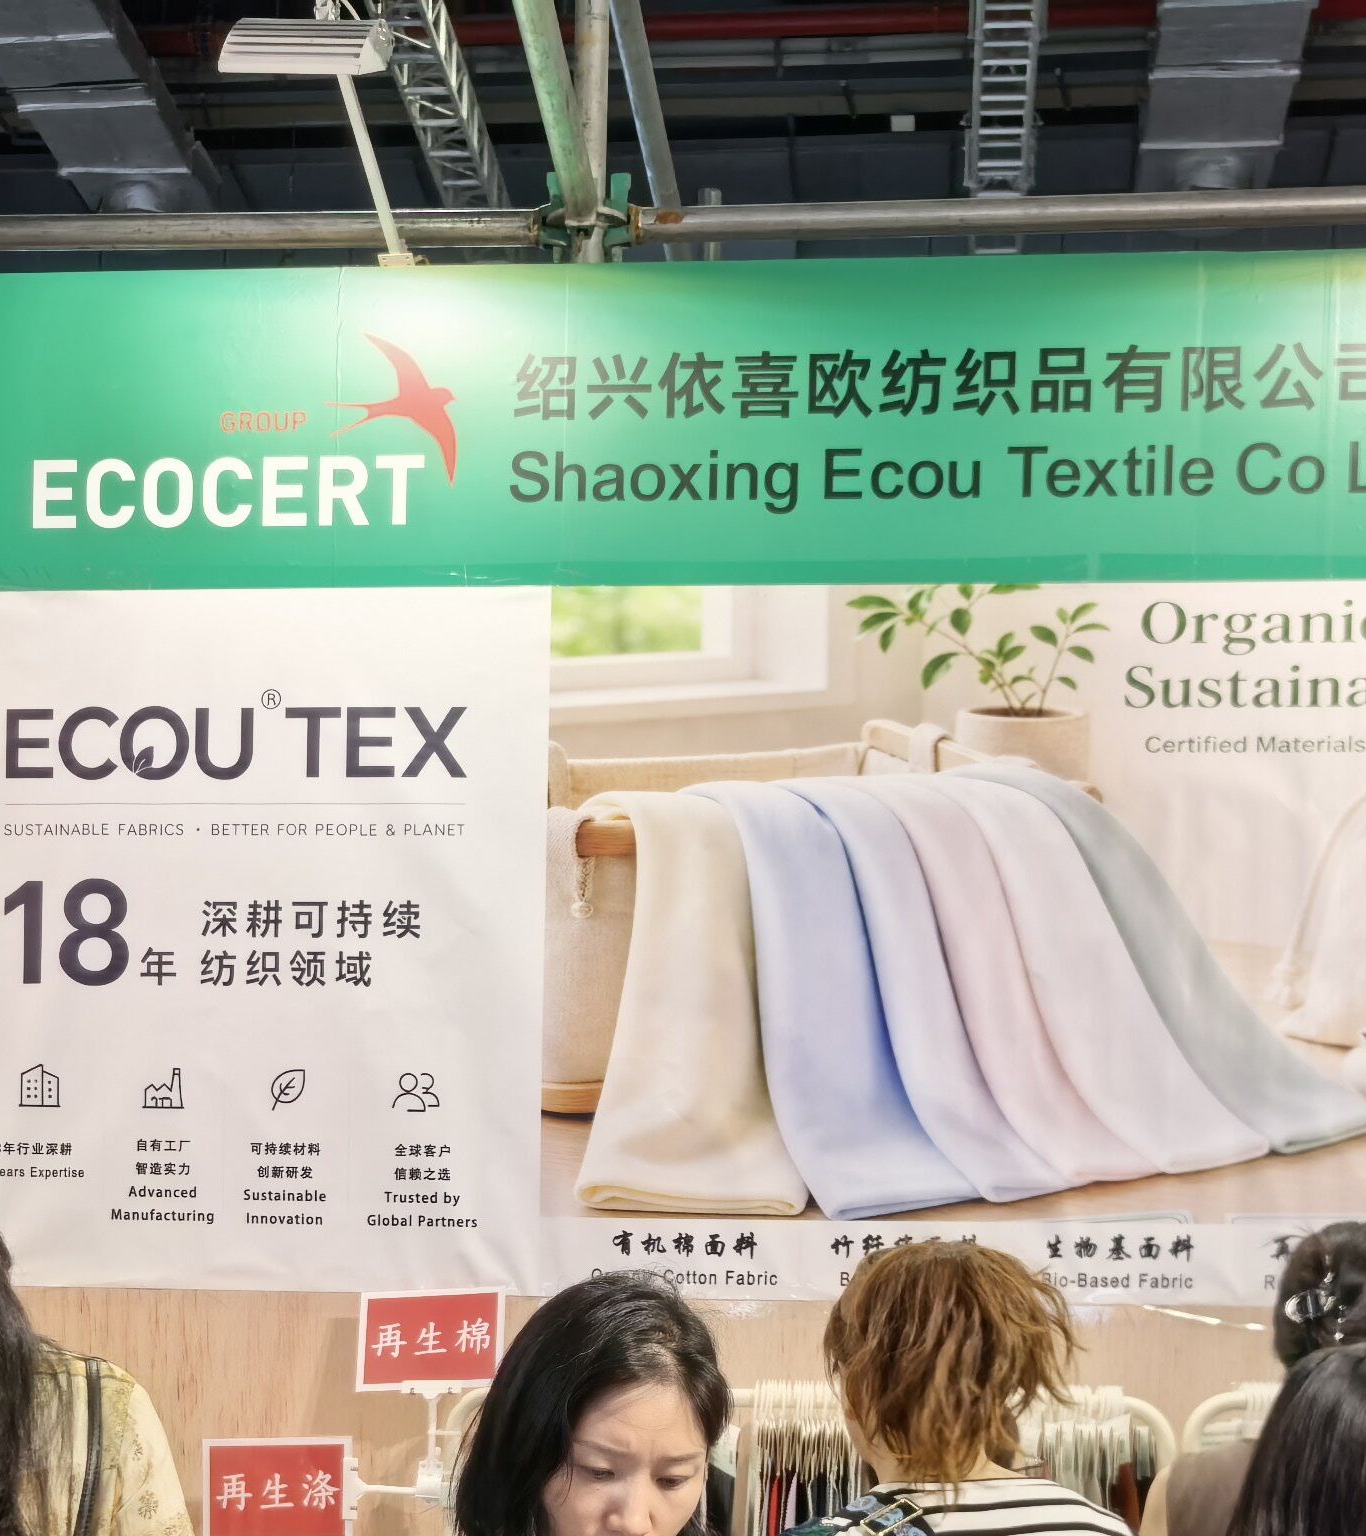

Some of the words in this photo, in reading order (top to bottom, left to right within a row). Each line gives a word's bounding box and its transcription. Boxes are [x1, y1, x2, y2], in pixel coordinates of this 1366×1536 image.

[219, 410, 308, 433] GROUP
[509, 448, 800, 515] Shaoxing
[823, 447, 982, 501] Ecou
[1008, 443, 1216, 499] Textile
[1235, 441, 1325, 498] Co
[31, 453, 426, 530] ECOCERT
[285, 705, 469, 779] TEX
[1144, 734, 1248, 754] Certified
[1256, 734, 1366, 754] Materials
[3, 823, 110, 837] SUSTAINABLE
[118, 823, 185, 837] FABRICS
[211, 823, 270, 837] BETTER
[277, 823, 309, 837] FOR
[315, 823, 378, 838] PEOPLE
[386, 824, 397, 838] &
[403, 823, 466, 838] PLANET
[200, 899, 422, 940] 深耕可持续
[3, 877, 178, 987] 18年
[199, 949, 373, 988] 纺织领域
[136, 1138, 191, 1152] 自有工厂
[250, 1142, 321, 1156] 可持续材料
[394, 1143, 452, 1158] 全球客户
[30, 1166, 85, 1180] Expertise
[135, 1161, 191, 1176] 智造实力
[257, 1165, 314, 1180] 创新研发
[394, 1167, 452, 1181] 信赖之选
[128, 1185, 197, 1199] Advanced
[243, 1188, 327, 1203] Sustainable
[384, 1191, 438, 1205] Trusted
[443, 1191, 461, 1207] by
[110, 1208, 215, 1225] Manufacturing
[246, 1212, 324, 1226] Innovation
[367, 1213, 413, 1228] Global
[417, 1214, 478, 1229] Partners
[612, 1231, 759, 1260] 有机棉面料
[1045, 1233, 1195, 1262] 生物基面料
[725, 1270, 778, 1286] Fabric
[1042, 1272, 1131, 1290] Bio-Based
[1138, 1273, 1195, 1290] Fabric
[370, 1317, 492, 1359] 再生棉
[215, 1469, 341, 1513] 再生涤
